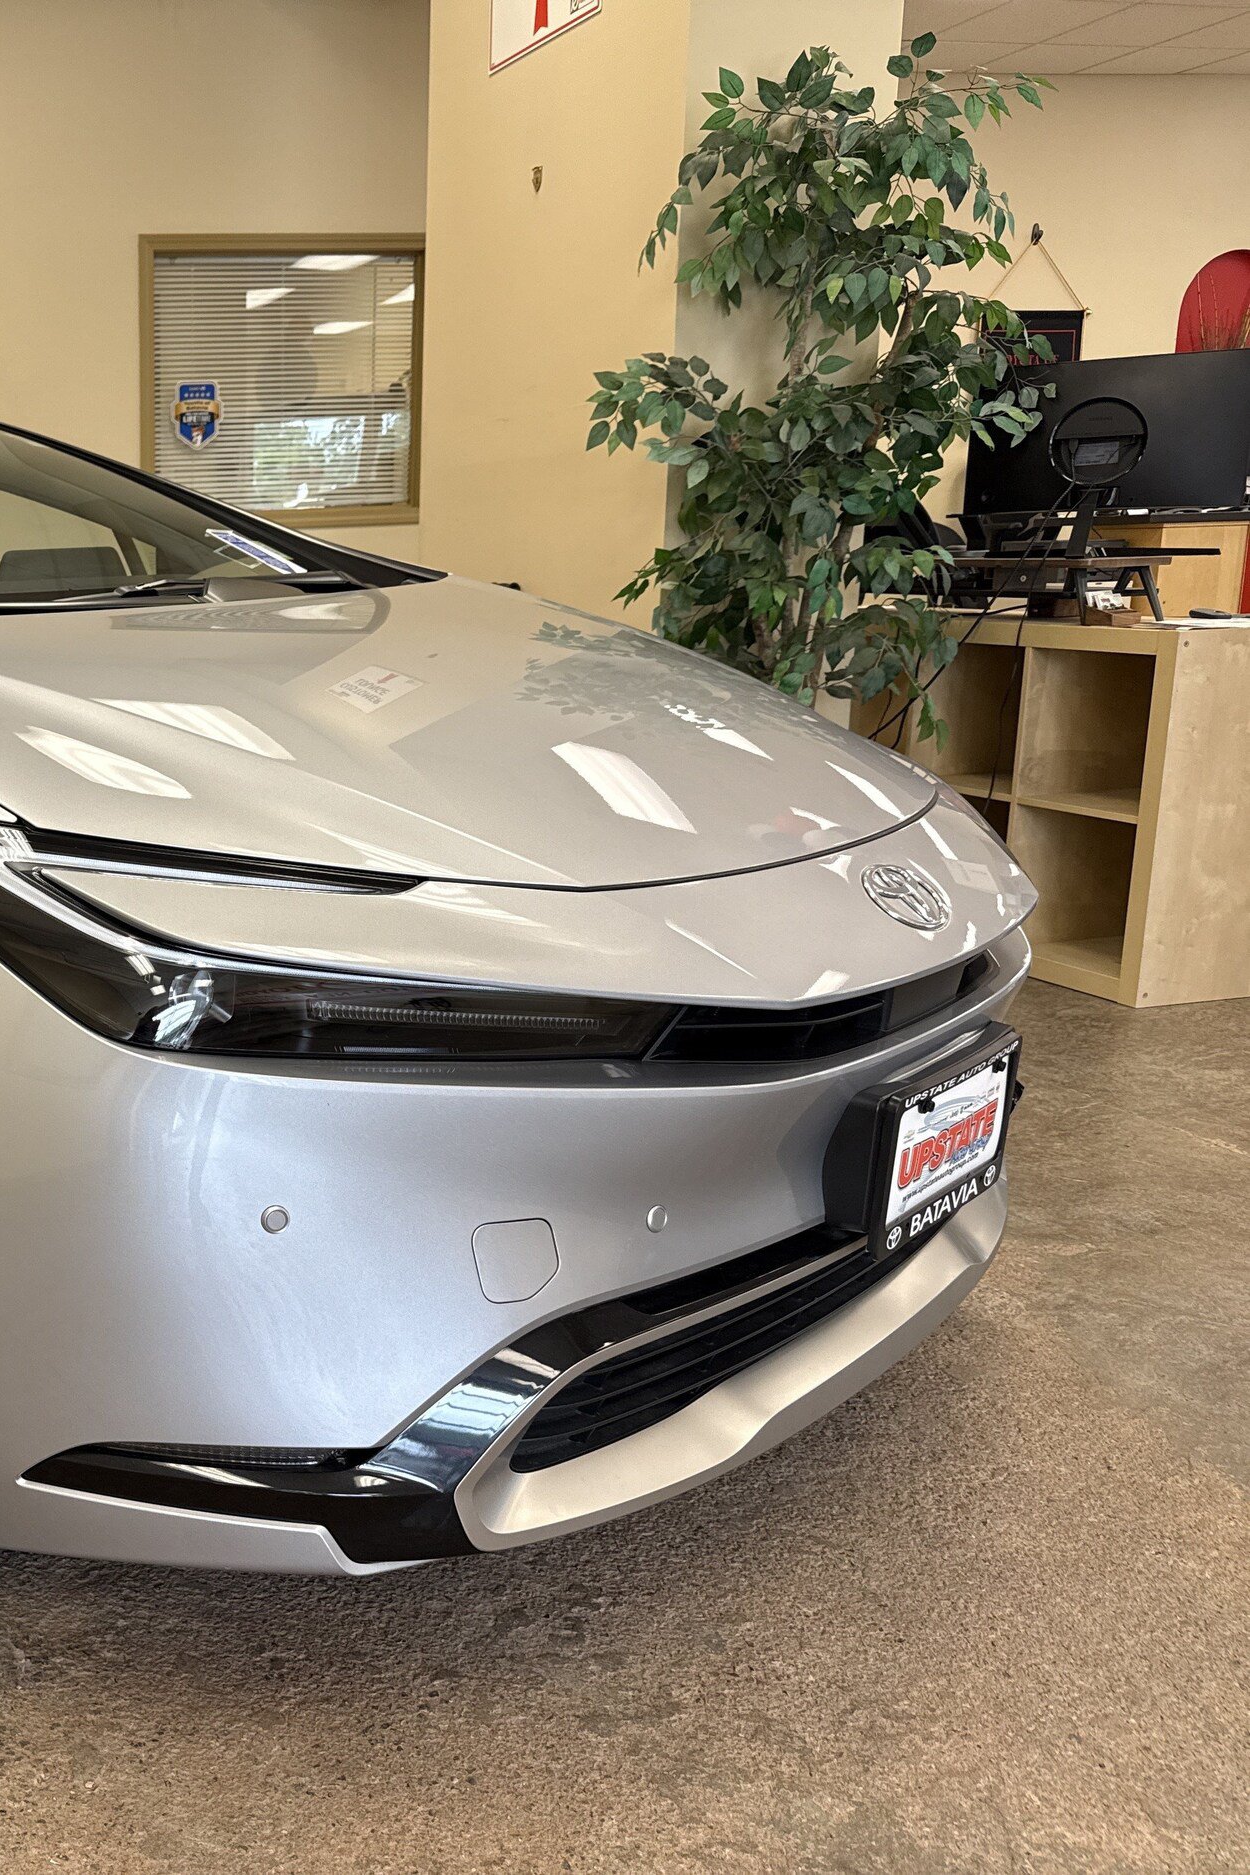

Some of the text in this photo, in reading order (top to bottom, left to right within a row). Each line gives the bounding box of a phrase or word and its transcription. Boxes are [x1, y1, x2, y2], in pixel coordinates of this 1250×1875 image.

[904, 1040, 1019, 1108] UPSTATE AUTO GROUP
[897, 1098, 999, 1189] UPSTATE
[909, 1178, 979, 1238] BATAVIA
